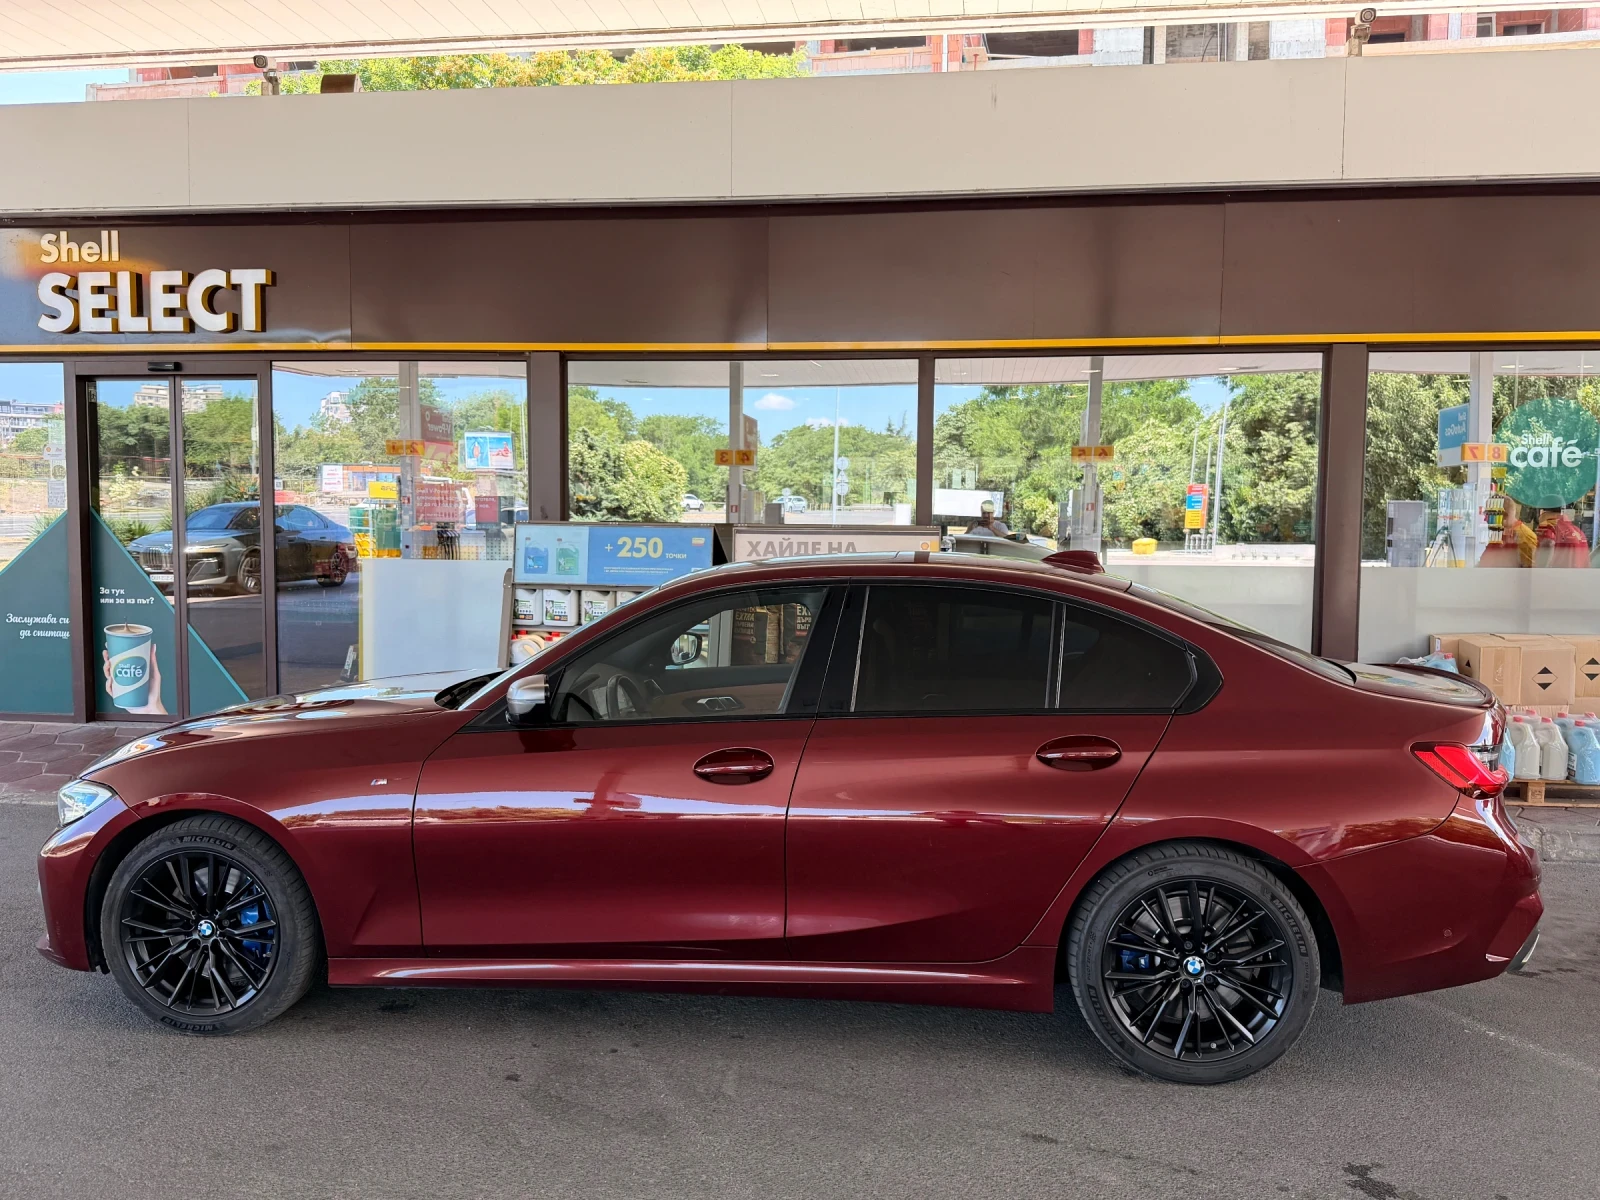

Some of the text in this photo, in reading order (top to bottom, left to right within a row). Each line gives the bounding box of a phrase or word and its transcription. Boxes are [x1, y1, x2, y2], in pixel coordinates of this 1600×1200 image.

[40, 230, 120, 263] Shell
[37, 268, 276, 333] SELECT
[1521, 433, 1550, 445] Shell
[1510, 436, 1582, 468] café
[747, 537, 822, 557] ХАЙДЕ
[99, 587, 125, 596] За тук
[136, 596, 155, 605] път?
[6, 613, 70, 625] Заслужава си
[19, 629, 70, 640] да опиташ
[116, 665, 143, 678] café
[182, 835, 235, 850] MICHELIN
[1272, 899, 1307, 956] MICHELIN
[1090, 986, 1121, 1044] MICHELIN
[163, 1017, 213, 1032] MICHELIN
